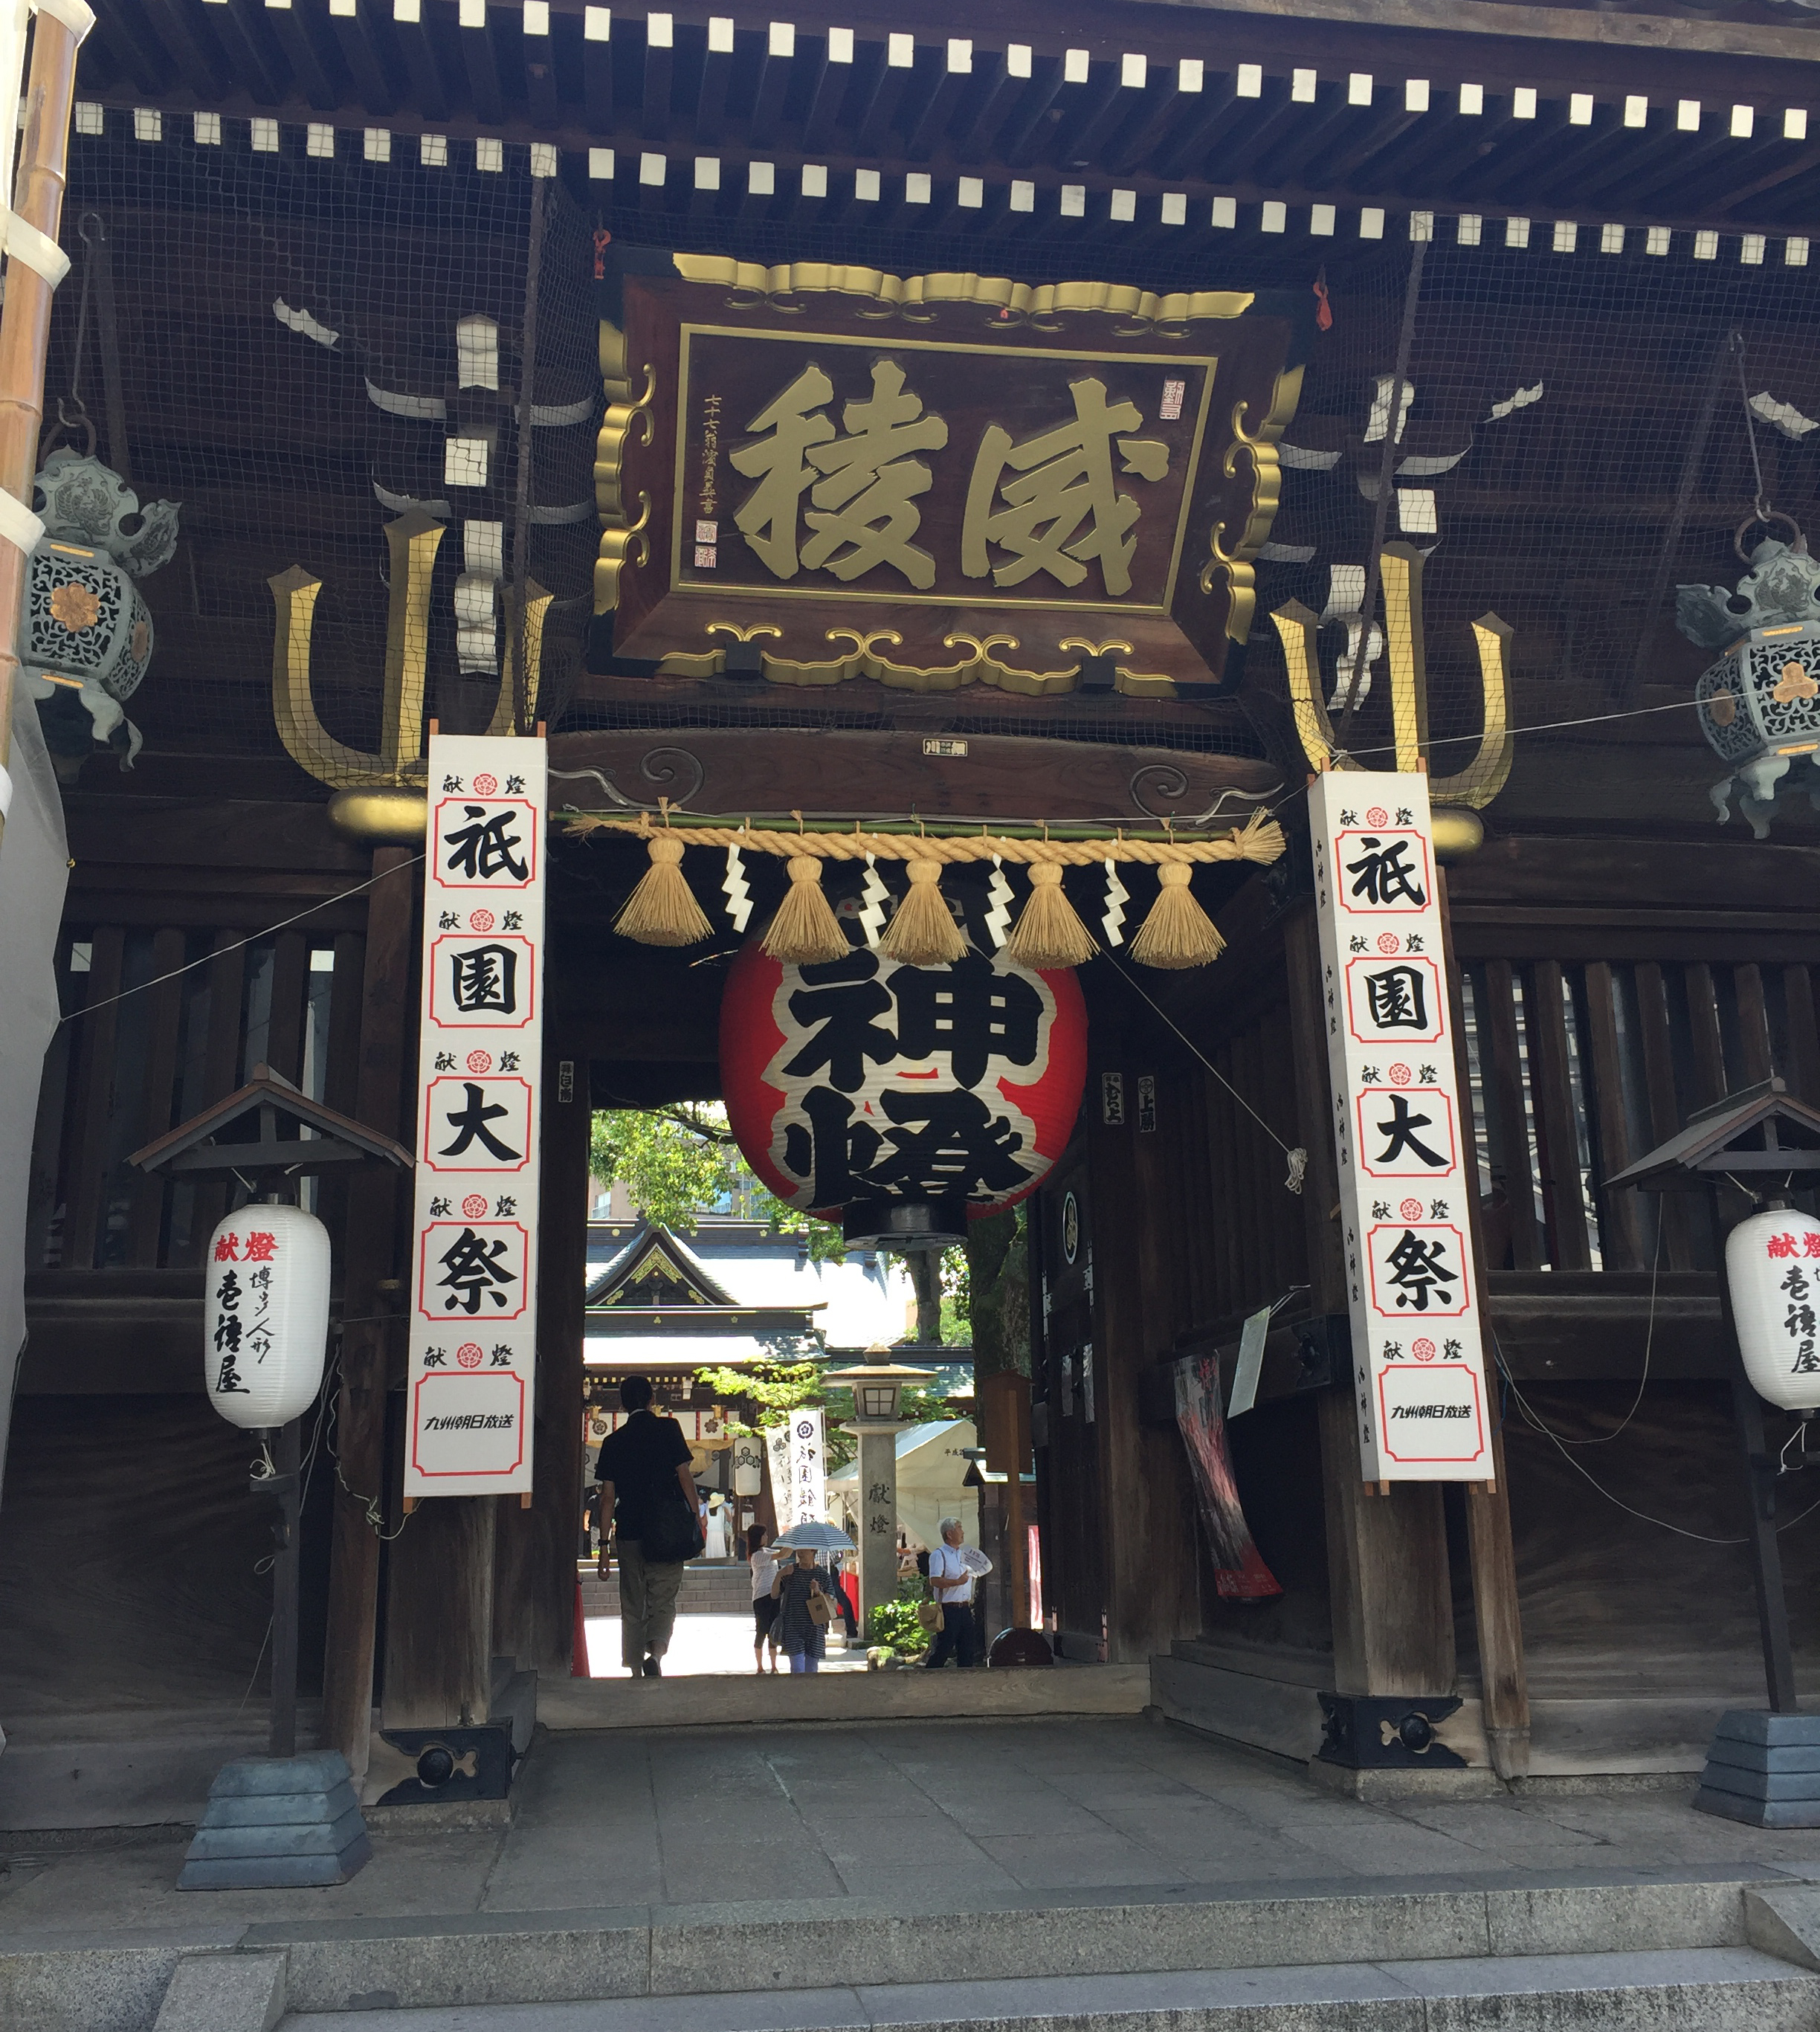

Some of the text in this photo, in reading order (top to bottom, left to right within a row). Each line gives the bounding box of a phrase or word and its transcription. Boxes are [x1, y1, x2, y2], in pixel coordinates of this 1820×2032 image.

[450, 944, 517, 1015] 園
[1363, 965, 1428, 1030] 園
[437, 1082, 523, 1162] 大
[1374, 1094, 1450, 1167] 大
[215, 1231, 279, 1262] 献燈
[435, 1227, 519, 1315] 祭
[1384, 1229, 1459, 1312] 祭
[245, 1265, 275, 1364] 博多人形
[424, 1413, 514, 1431] 九州朝日放送
[1390, 1404, 1472, 1419] 九州朝日放送
